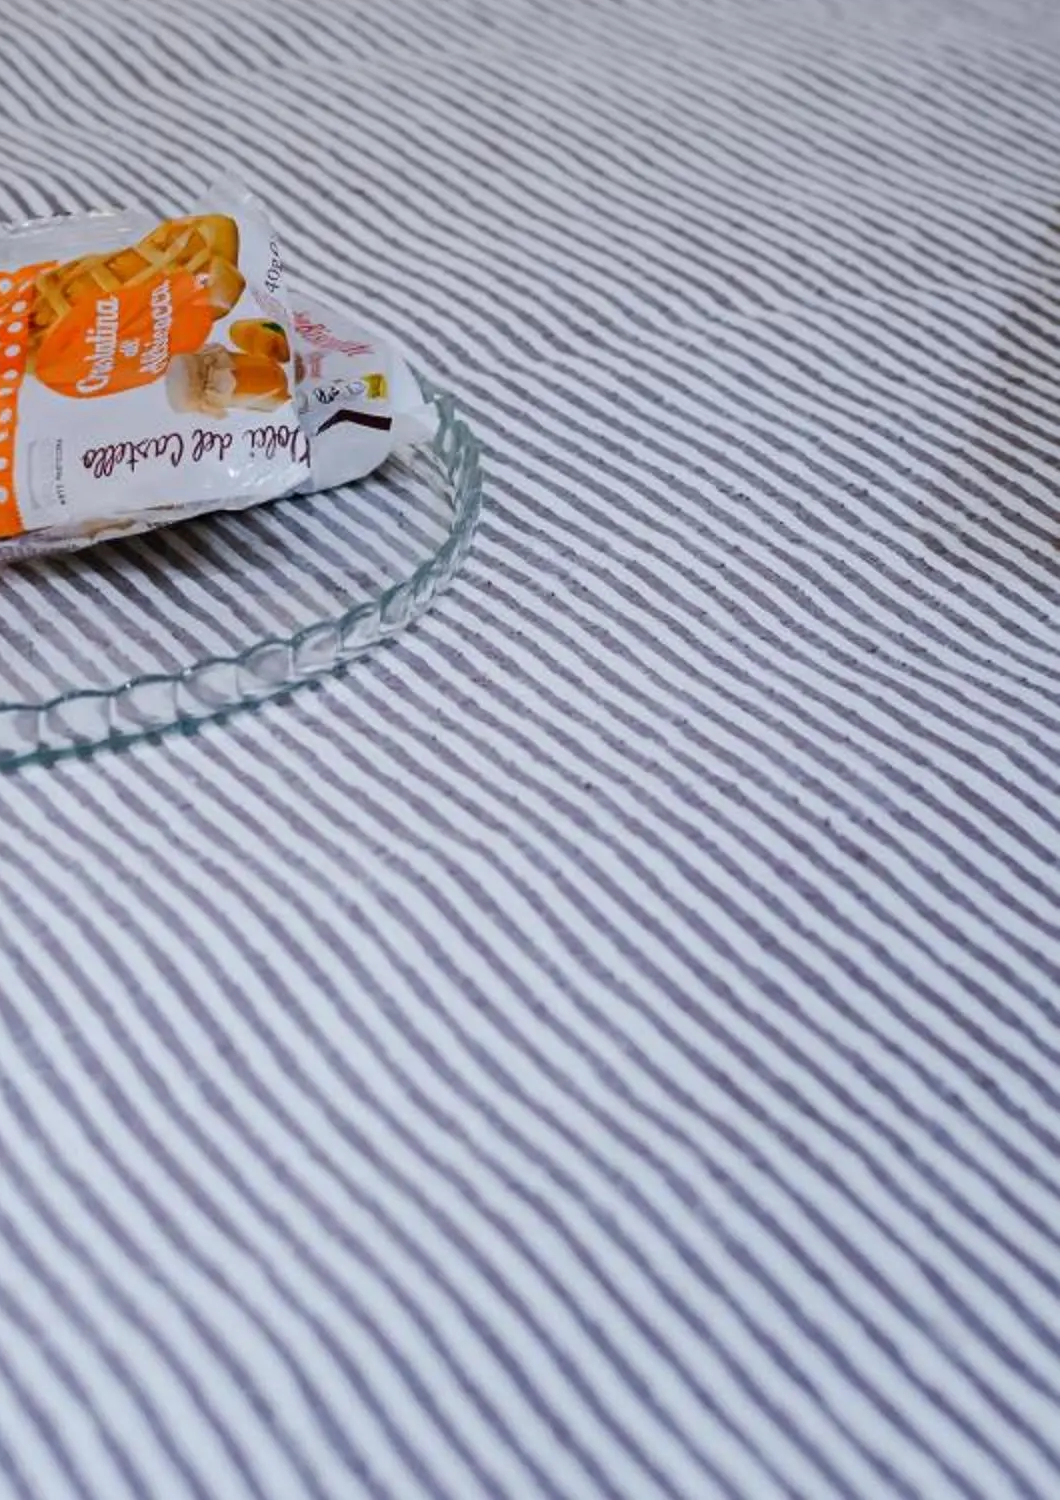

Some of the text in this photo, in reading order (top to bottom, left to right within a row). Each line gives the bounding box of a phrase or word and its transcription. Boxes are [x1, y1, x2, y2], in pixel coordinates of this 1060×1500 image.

[81, 432, 184, 479] Castello
[191, 429, 233, 463] del
[243, 425, 312, 469] Dolci
